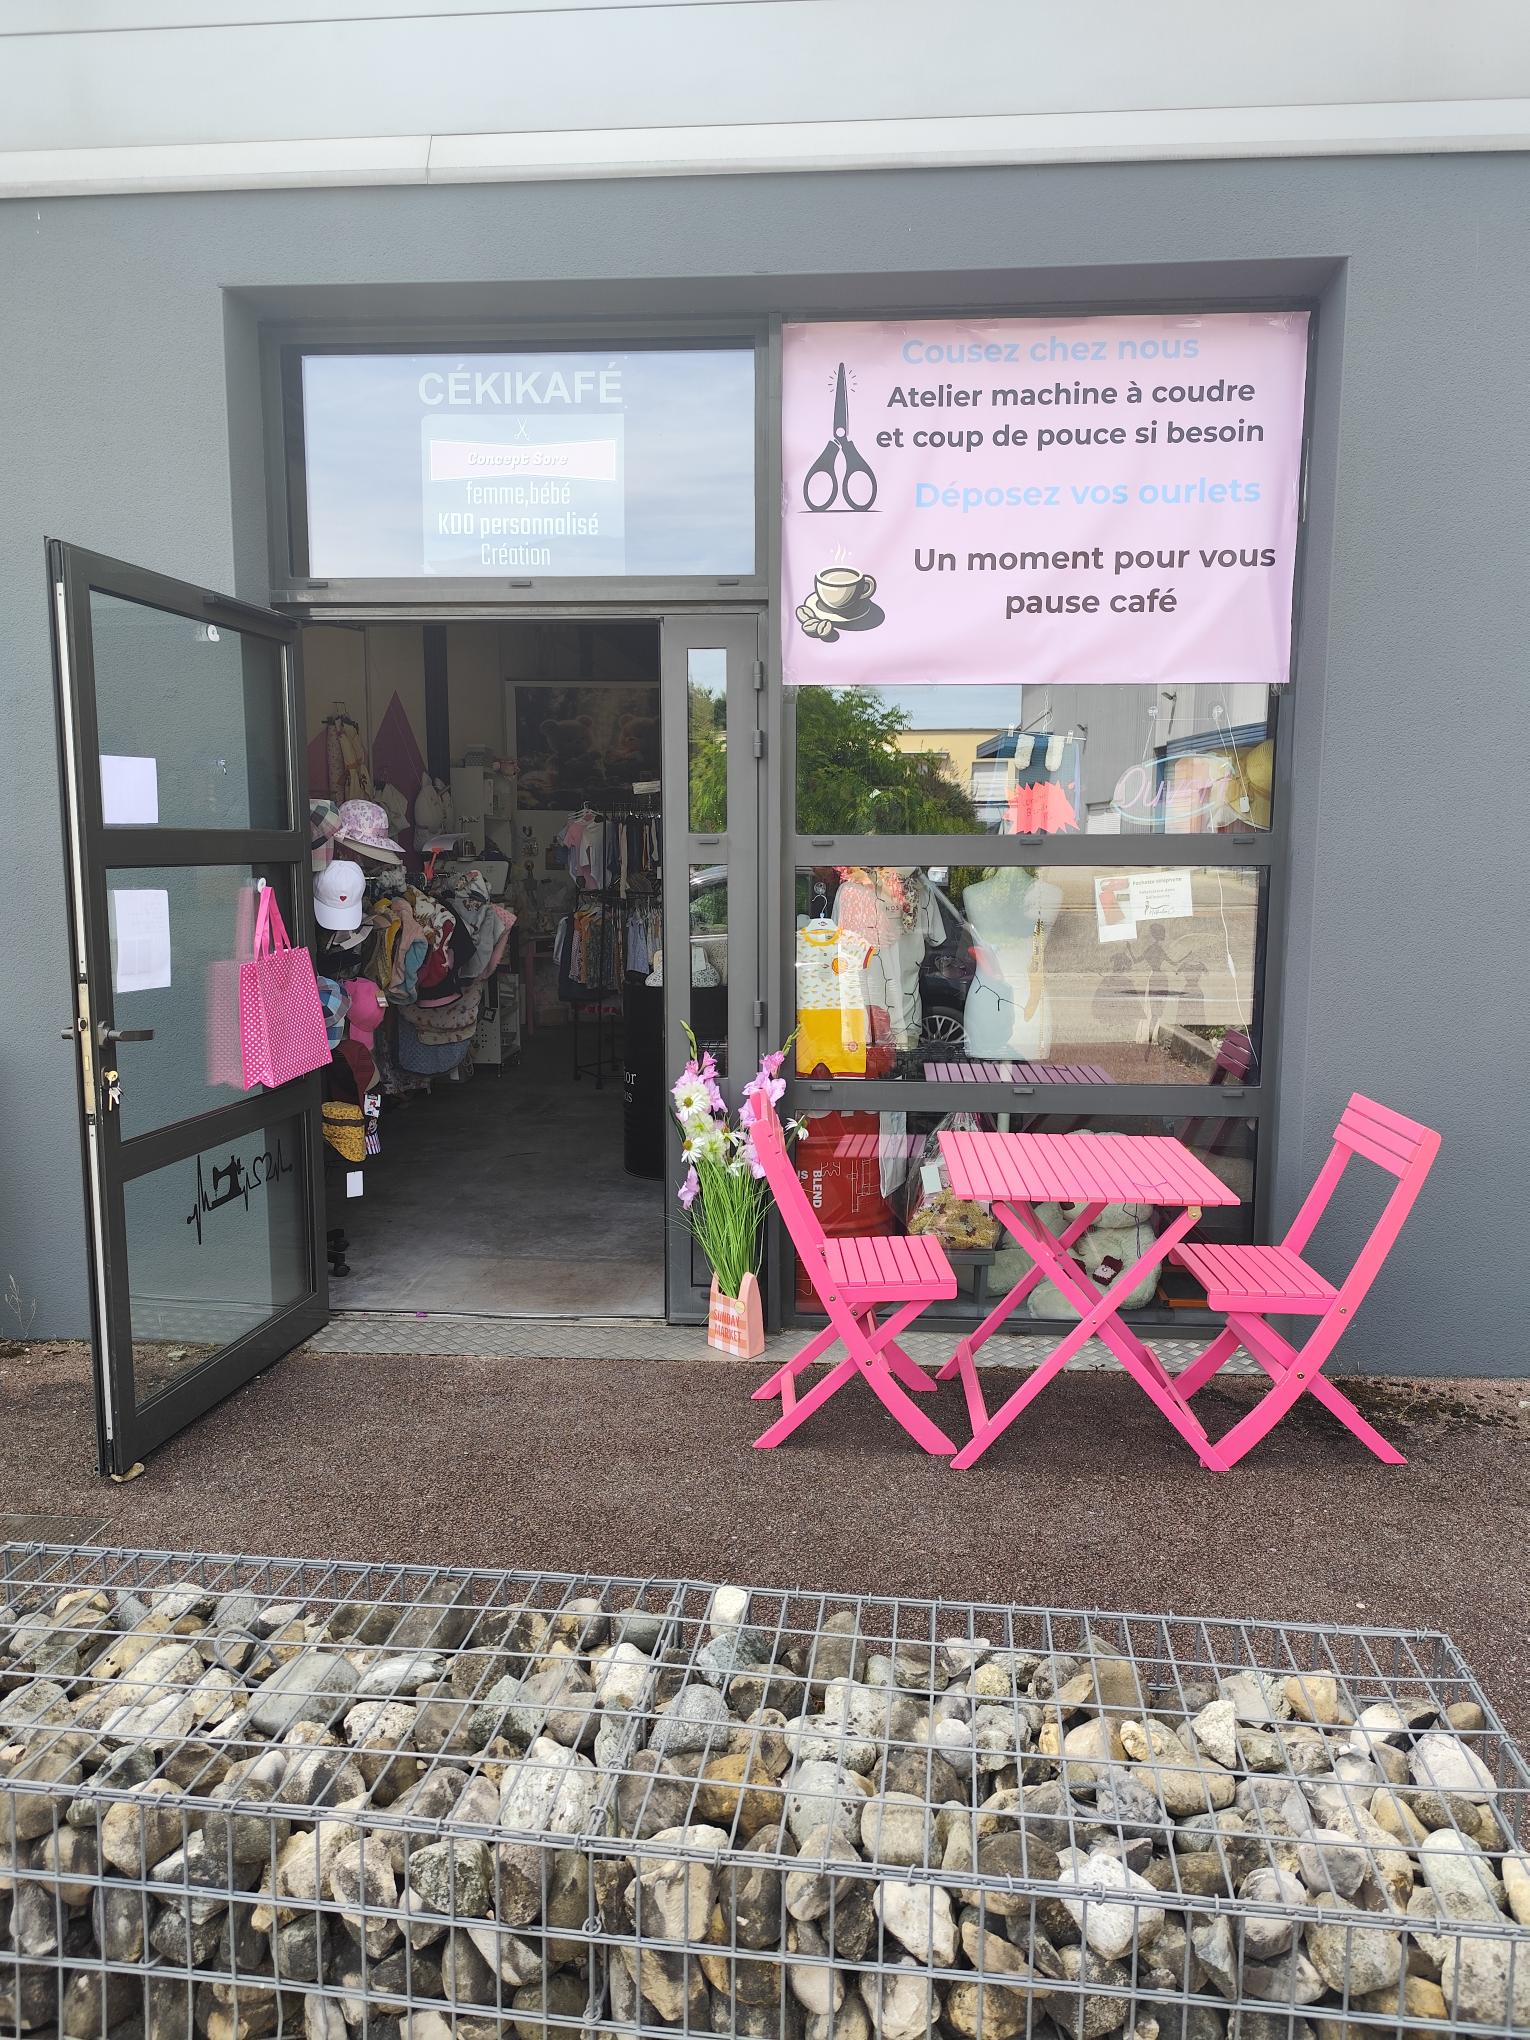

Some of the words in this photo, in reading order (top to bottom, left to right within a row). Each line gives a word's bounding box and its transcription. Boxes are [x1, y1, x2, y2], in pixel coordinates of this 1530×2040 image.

[902, 339, 1020, 364] Cousez
[1030, 336, 1106, 361] chez
[1118, 337, 1200, 360] nous
[418, 362, 623, 405] CÉKIKAFÉ
[887, 384, 983, 408] Atelier
[991, 381, 1118, 406] machine
[1126, 381, 1143, 403] à
[1152, 379, 1256, 403] coudre
[876, 428, 904, 448] et
[912, 428, 984, 452] coup
[992, 424, 1028, 447] de
[1037, 428, 1127, 451] pouce
[1134, 420, 1157, 444] si
[1167, 419, 1264, 443] besoin
[467, 451, 530, 469] Concept
[914, 481, 1061, 513] Déposez
[1071, 482, 1129, 504] vos
[1139, 478, 1262, 504] ourlets
[438, 512, 475, 536] KDO
[480, 512, 600, 538] personnalisé
[481, 542, 551, 566] Création
[914, 548, 956, 571] Un
[967, 547, 1104, 570] moment
[1114, 549, 1190, 575] pour
[1199, 547, 1276, 568] vous
[1005, 594, 1100, 619] pause
[1109, 588, 1177, 613] café
[812, 1170, 823, 1209] BLEND
[713, 1309, 740, 1327] SUNDAY
[715, 1323, 741, 1342] MARKET
